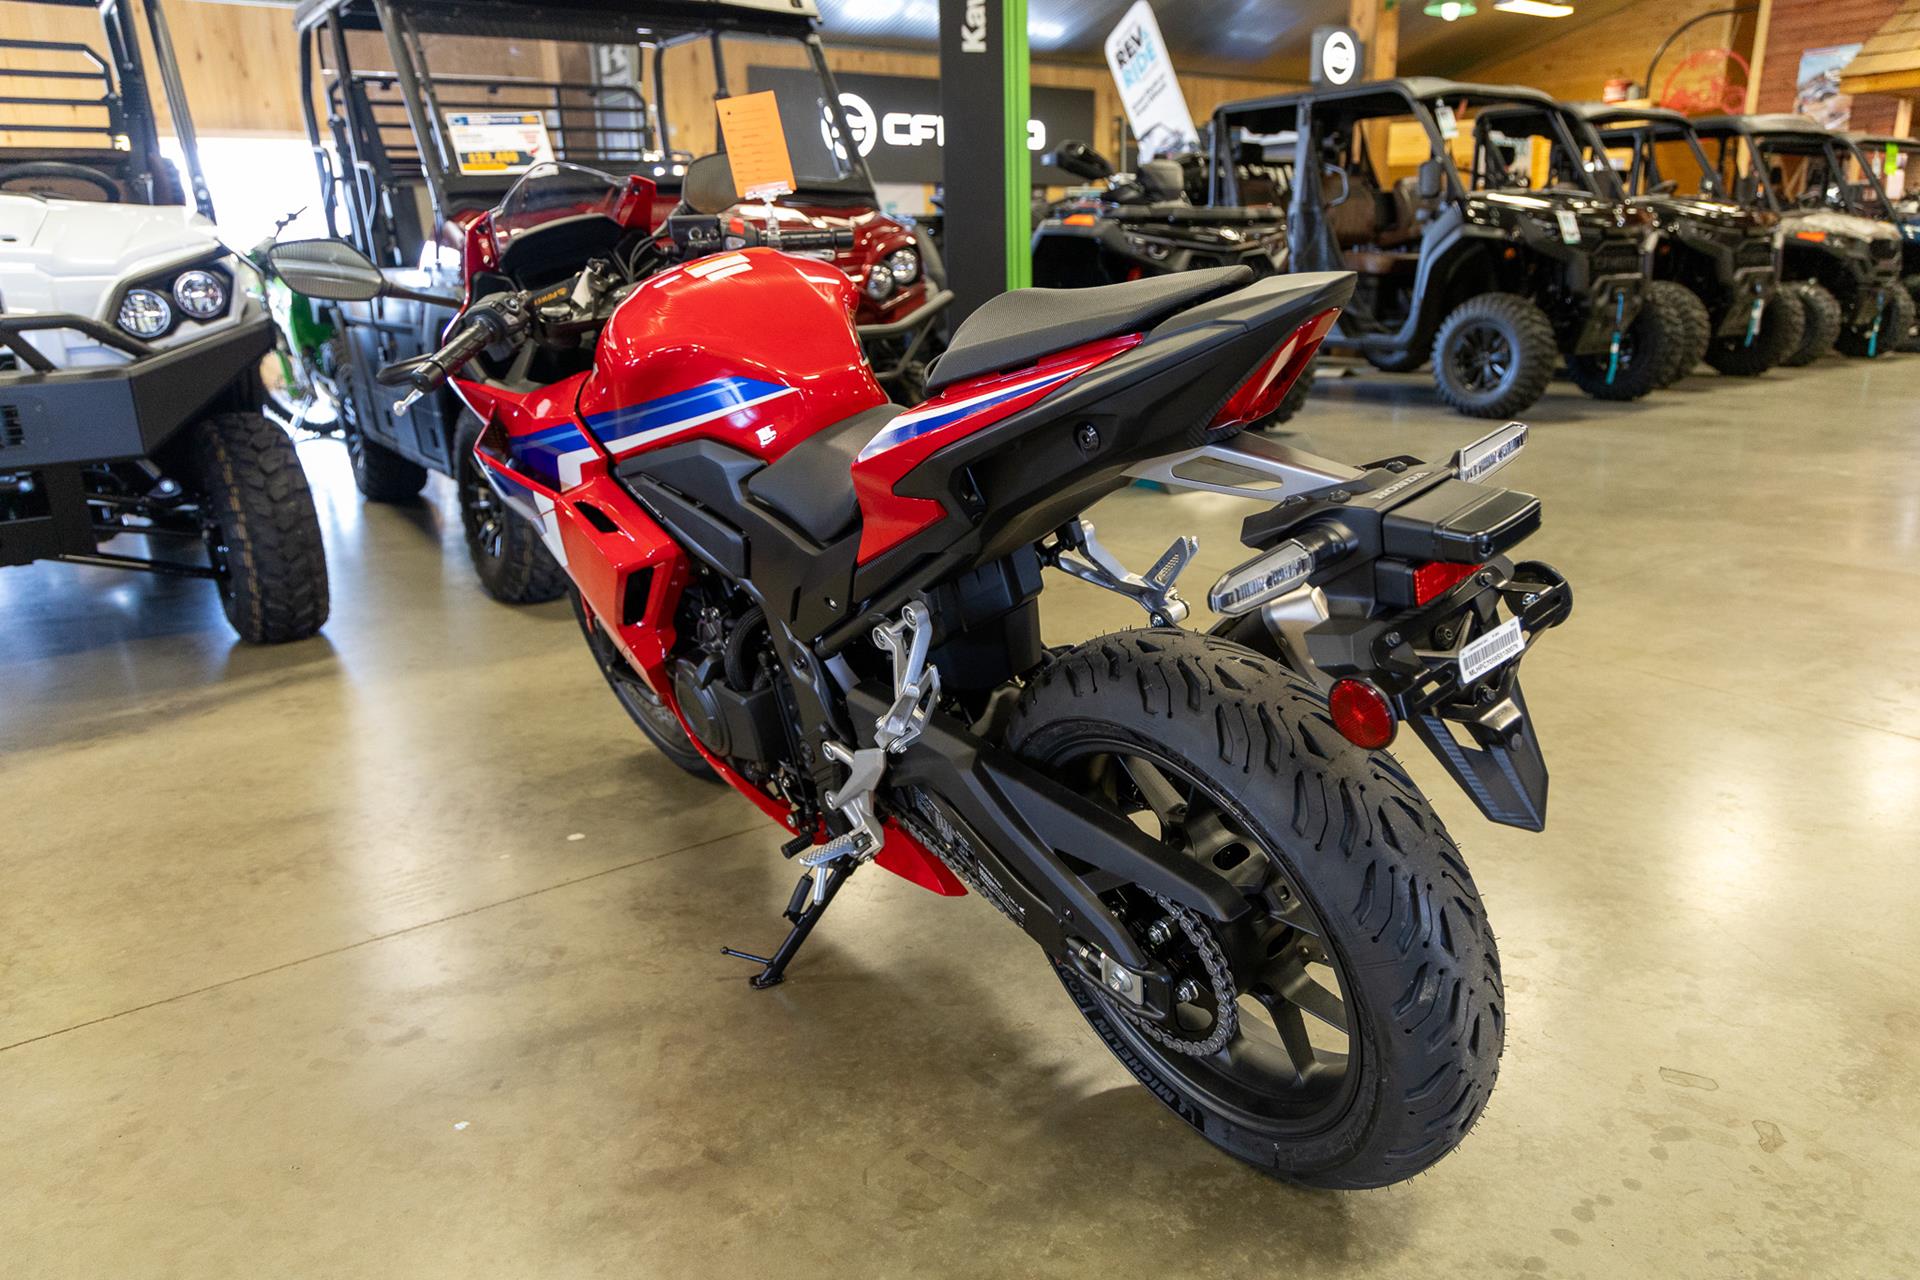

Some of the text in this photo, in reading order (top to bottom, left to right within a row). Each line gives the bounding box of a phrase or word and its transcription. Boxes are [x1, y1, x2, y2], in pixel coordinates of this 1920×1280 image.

[961, 0, 986, 52] Ka
[1115, 25, 1142, 69] REV
[1370, 471, 1430, 500] HONDA
[1095, 1018, 1178, 1102] MICHELIN
